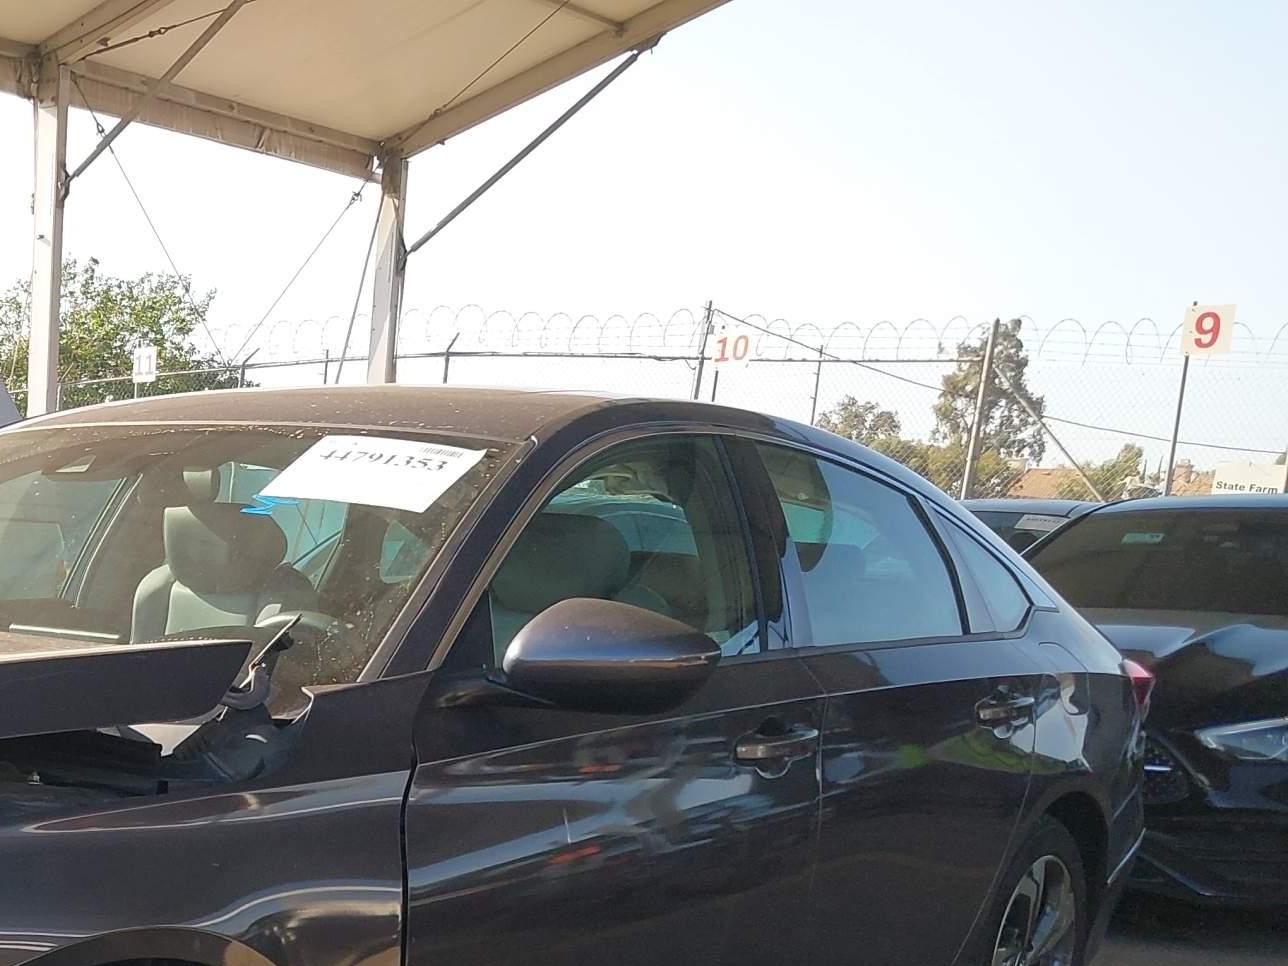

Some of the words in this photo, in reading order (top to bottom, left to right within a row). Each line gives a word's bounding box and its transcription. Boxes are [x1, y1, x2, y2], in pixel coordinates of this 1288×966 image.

[1194, 311, 1221, 349] 9
[714, 335, 749, 362] 10
[134, 354, 155, 376] 11
[319, 449, 448, 472] 44791353
[1215, 480, 1246, 492] State
[1249, 483, 1279, 495] Farm
